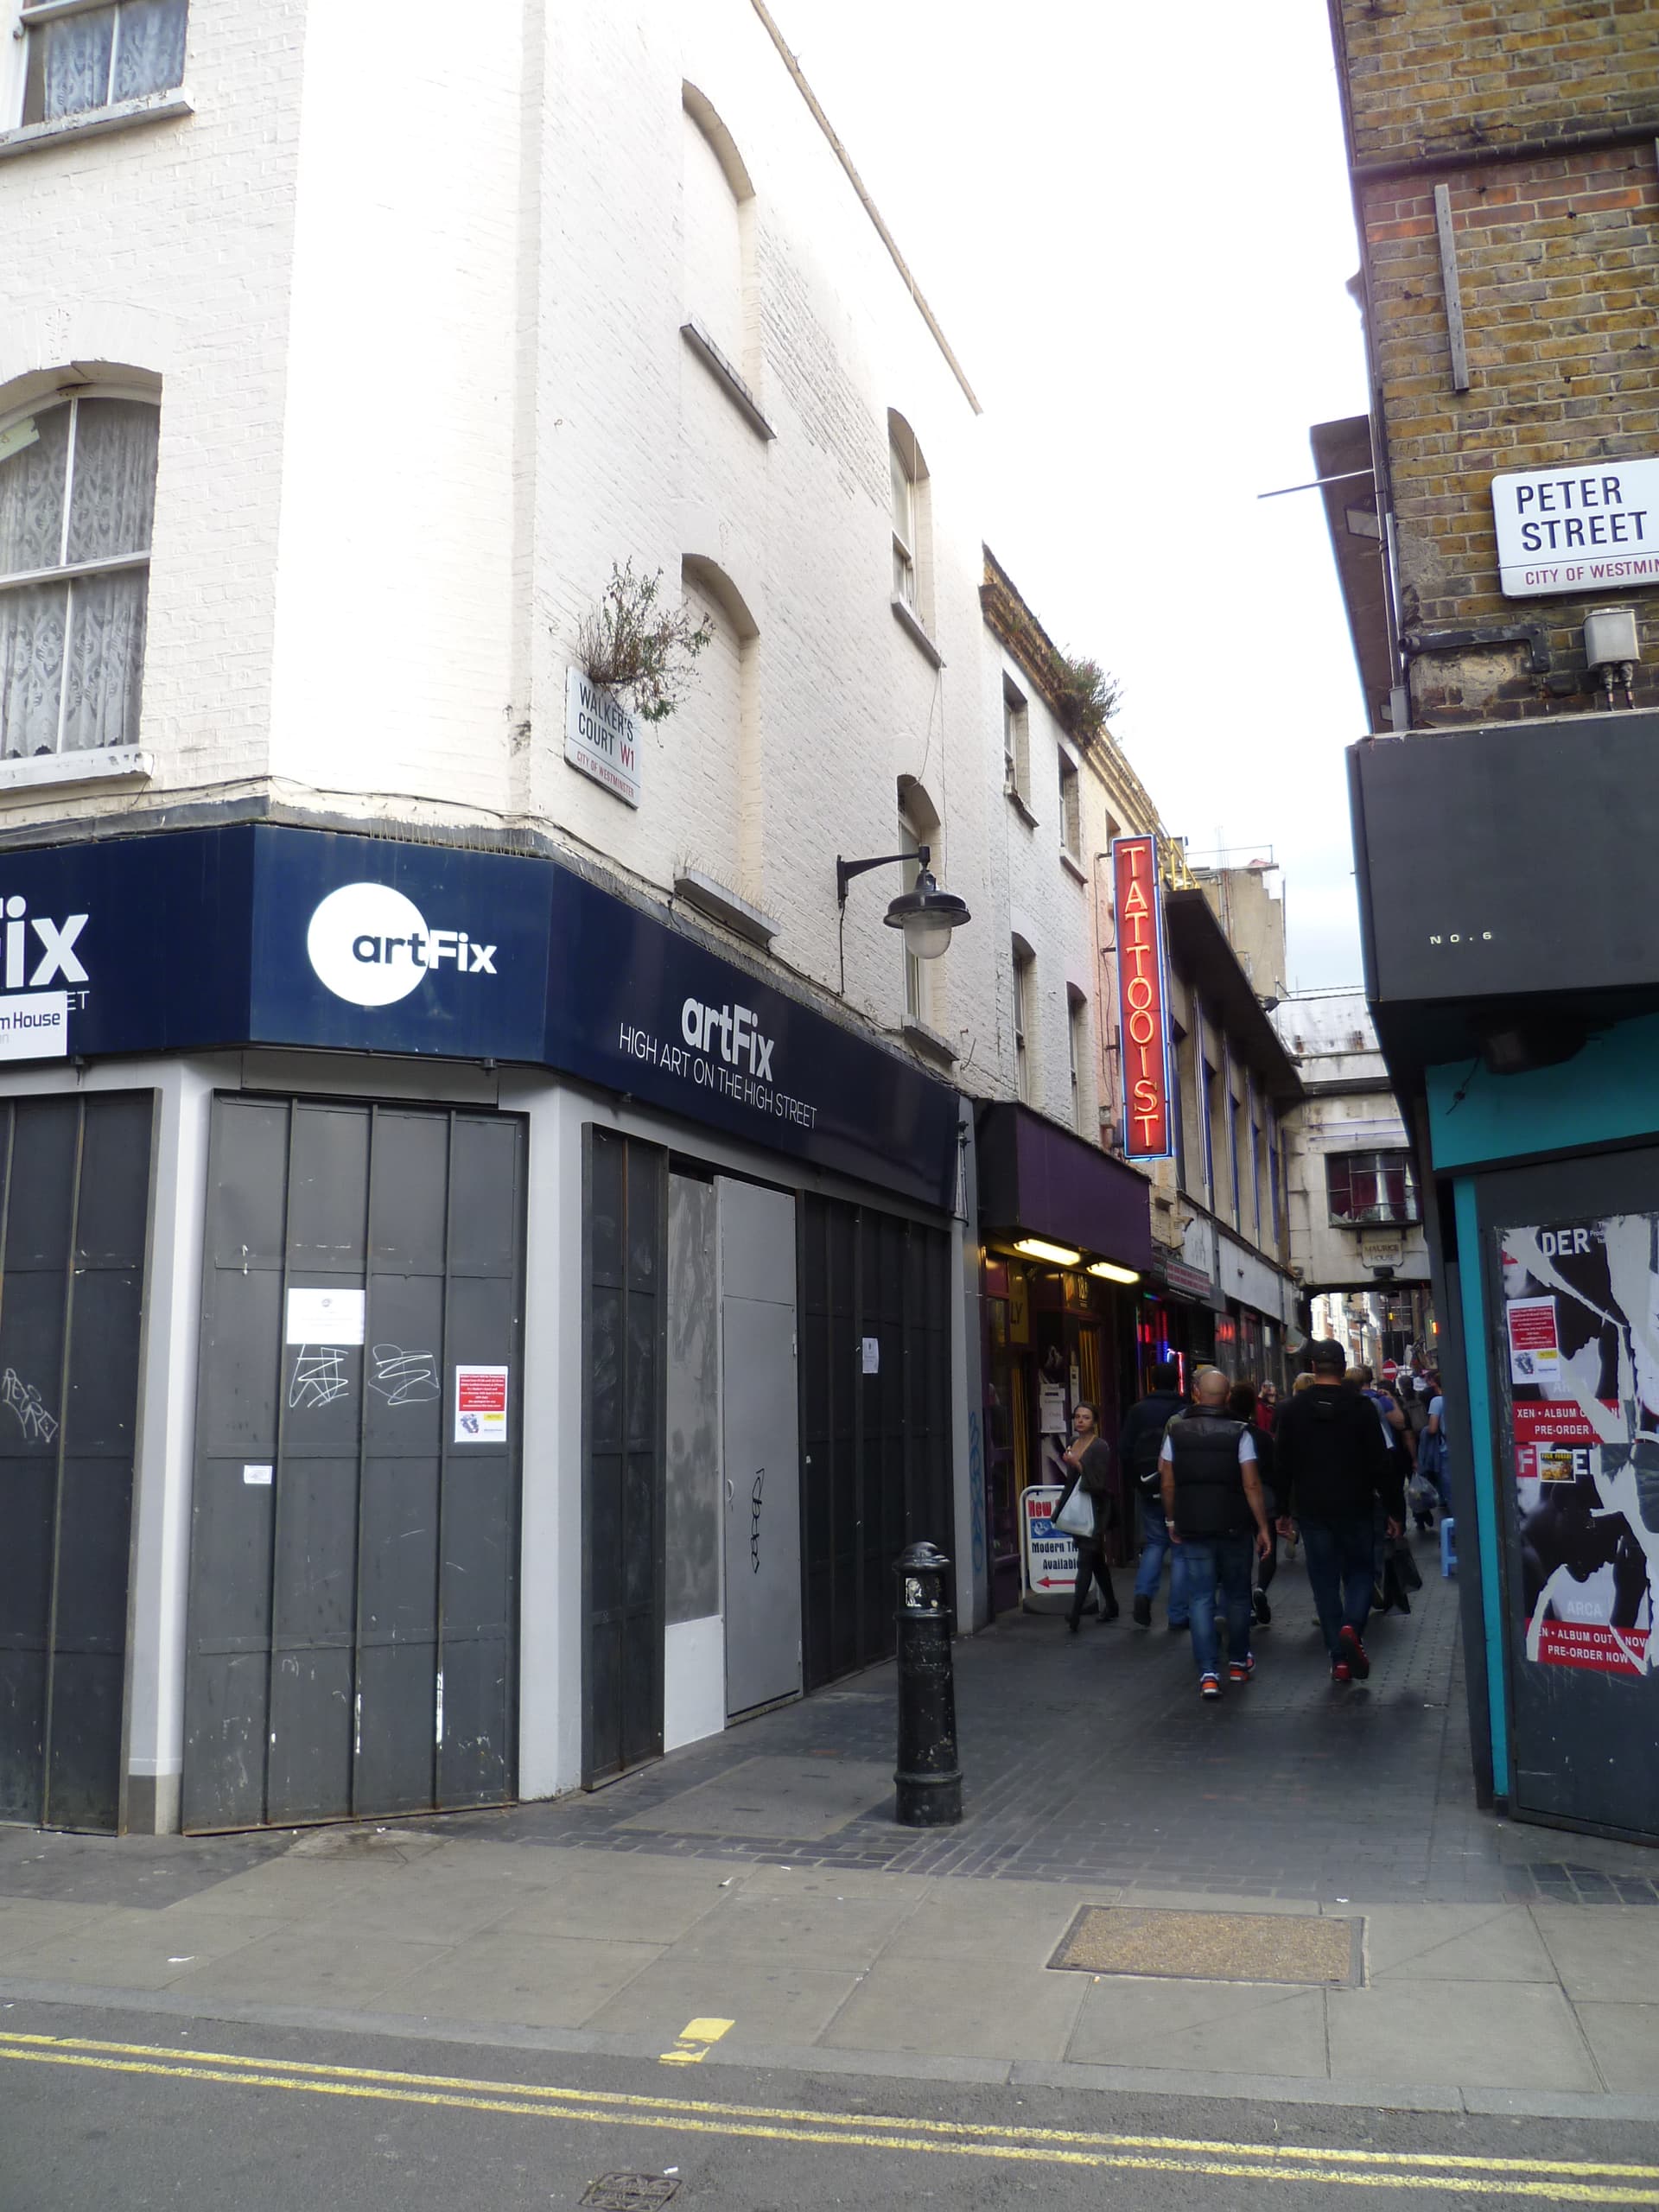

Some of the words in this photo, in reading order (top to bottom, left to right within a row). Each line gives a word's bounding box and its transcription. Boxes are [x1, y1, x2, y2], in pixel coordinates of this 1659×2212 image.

[1516, 476, 1623, 515] PETER
[1521, 511, 1648, 552] STREET
[1525, 569, 1559, 586] CITY
[1566, 566, 1584, 581] OF
[579, 682, 634, 742] WALKER'S
[578, 712, 615, 756] COURT
[620, 741, 635, 772] W1
[576, 750, 589, 766] CITY
[590, 759, 598, 772] OF
[599, 766, 634, 798] WESTMINSTER
[0, 895, 90, 988] ix
[351, 928, 499, 976] artFix
[1121, 846, 1160, 1148] TATTOOIST
[13, 1009, 61, 1030] House
[681, 997, 775, 1083] artFix
[619, 1022, 658, 1065] HIGH
[659, 1043, 691, 1078] ART
[693, 1058, 715, 1090] ON
[717, 1066, 743, 1101] THE
[744, 1078, 774, 1114] HIGH
[775, 1092, 818, 1129] STREET
[1517, 1408, 1535, 1418] XEN
[1544, 1408, 1577, 1418] ALBUM
[1535, 1425, 1590, 1435] PRE-ORDER
[1027, 1499, 1052, 1517] New
[1032, 1541, 1065, 1554] Modern
[1567, 1600, 1604, 1618] ARCA
[1548, 1644, 1603, 1661] PRE-ORDER
[1606, 1652, 1628, 1664] NOW
[1557, 1630, 1591, 1642] ALBUM
[1593, 1632, 1613, 1644] OUT
